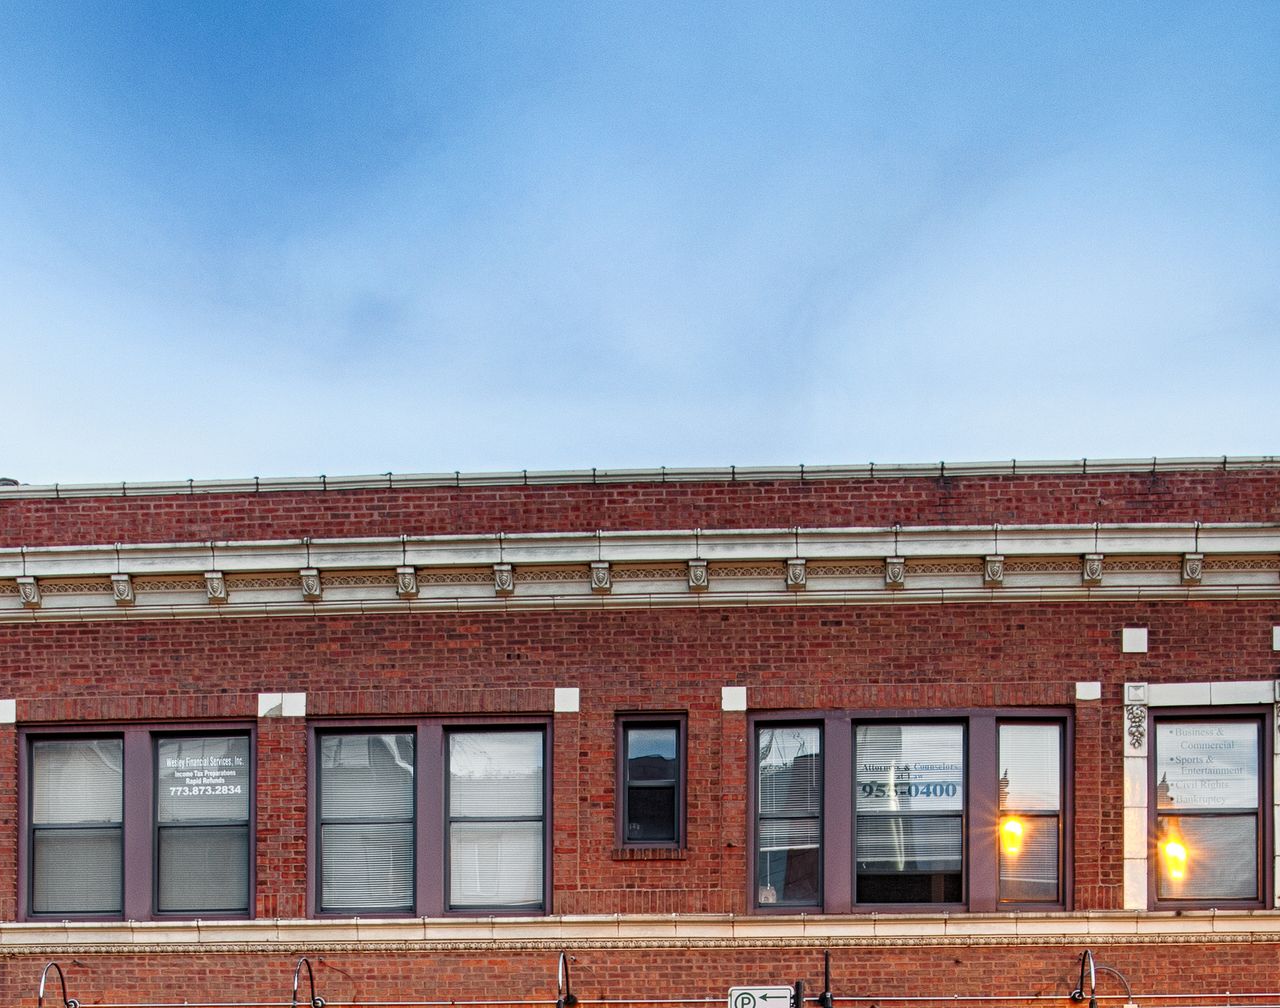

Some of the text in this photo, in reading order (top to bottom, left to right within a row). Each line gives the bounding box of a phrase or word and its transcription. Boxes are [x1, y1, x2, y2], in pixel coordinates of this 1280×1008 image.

[1176, 728, 1224, 736] Business &
[1181, 740, 1235, 749] Commercial
[166, 758, 185, 769] Wesley
[186, 757, 209, 766] Financial
[1175, 755, 1214, 765] Sports &
[913, 763, 958, 771] Counselors
[1181, 766, 1243, 775] Entertainment
[186, 777, 201, 785] Rapid
[1175, 781, 1229, 790] Civil Rights
[169, 785, 241, 796] 773.873.2834
[1177, 795, 1226, 805] Bankruptcy
